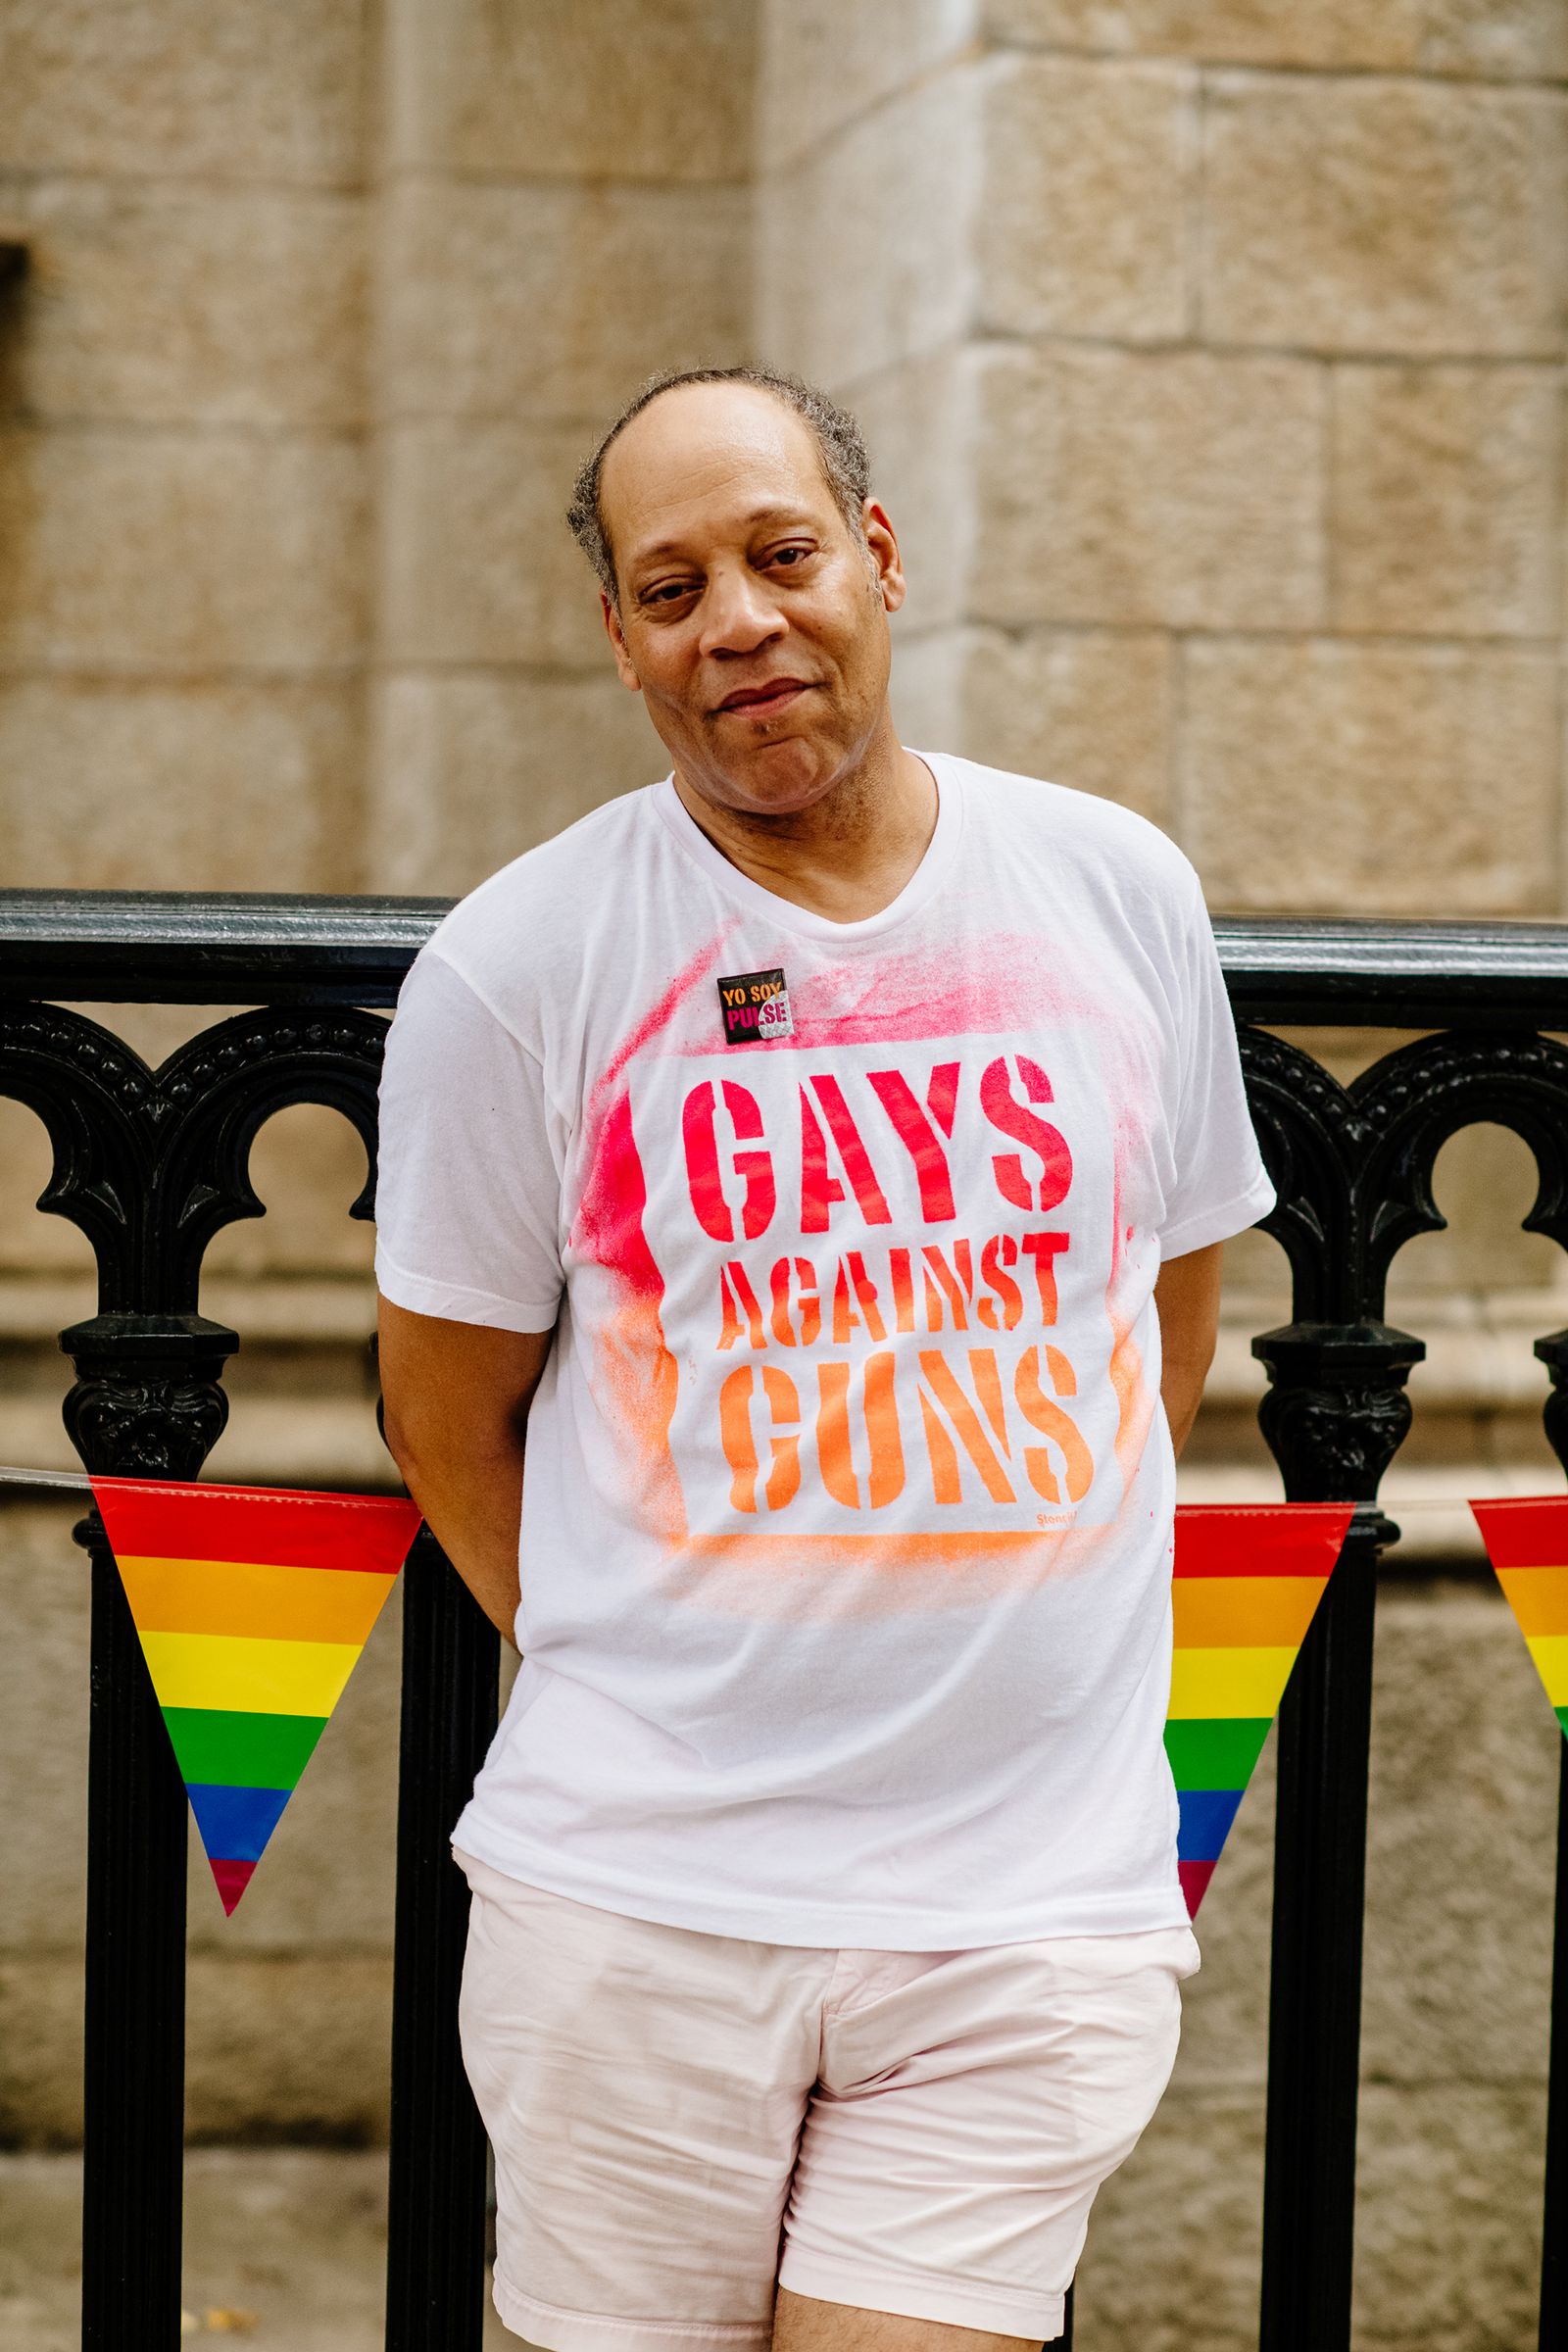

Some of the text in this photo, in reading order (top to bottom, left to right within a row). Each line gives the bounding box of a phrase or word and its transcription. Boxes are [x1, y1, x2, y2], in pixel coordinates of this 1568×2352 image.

[722, 981, 782, 1007] YO SOY
[726, 1002, 787, 1031] PULSE
[681, 1054, 1073, 1243] GAYS
[716, 1232, 1070, 1349] AGAINST
[718, 1345, 1094, 1514] GUNS
